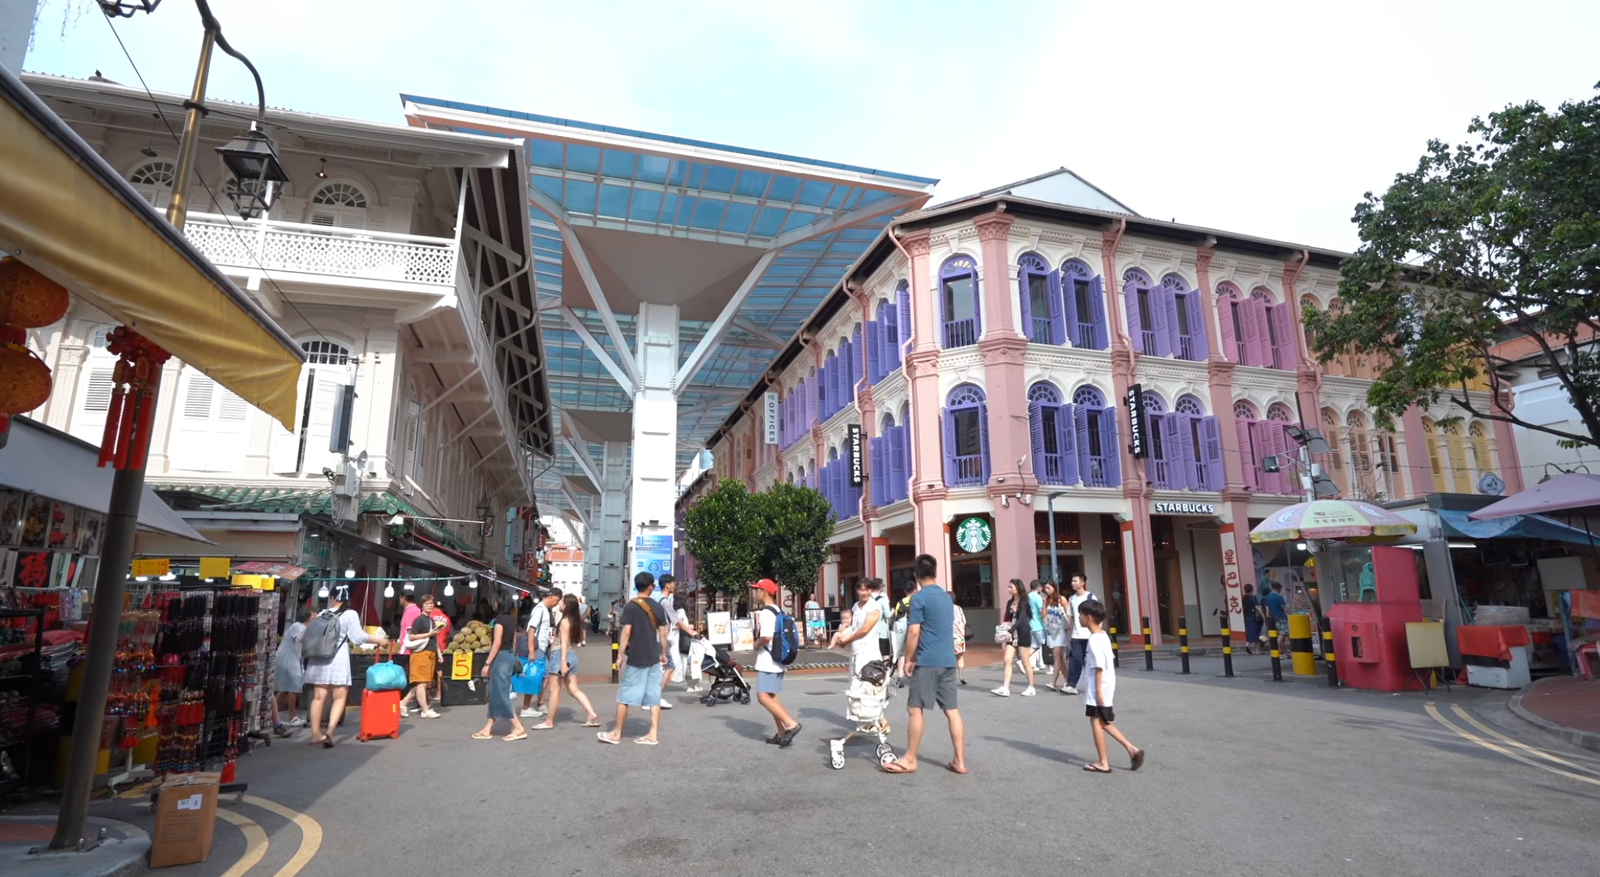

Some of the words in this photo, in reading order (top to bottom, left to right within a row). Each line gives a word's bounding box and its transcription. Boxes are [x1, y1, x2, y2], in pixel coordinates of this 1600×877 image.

[1128, 389, 1141, 454] STARBUCKS
[852, 427, 860, 482] STARBUCKS
[1155, 502, 1214, 514] STARBUCKS
[1224, 549, 1242, 615] 星巴克
[455, 660, 469, 676] 5
